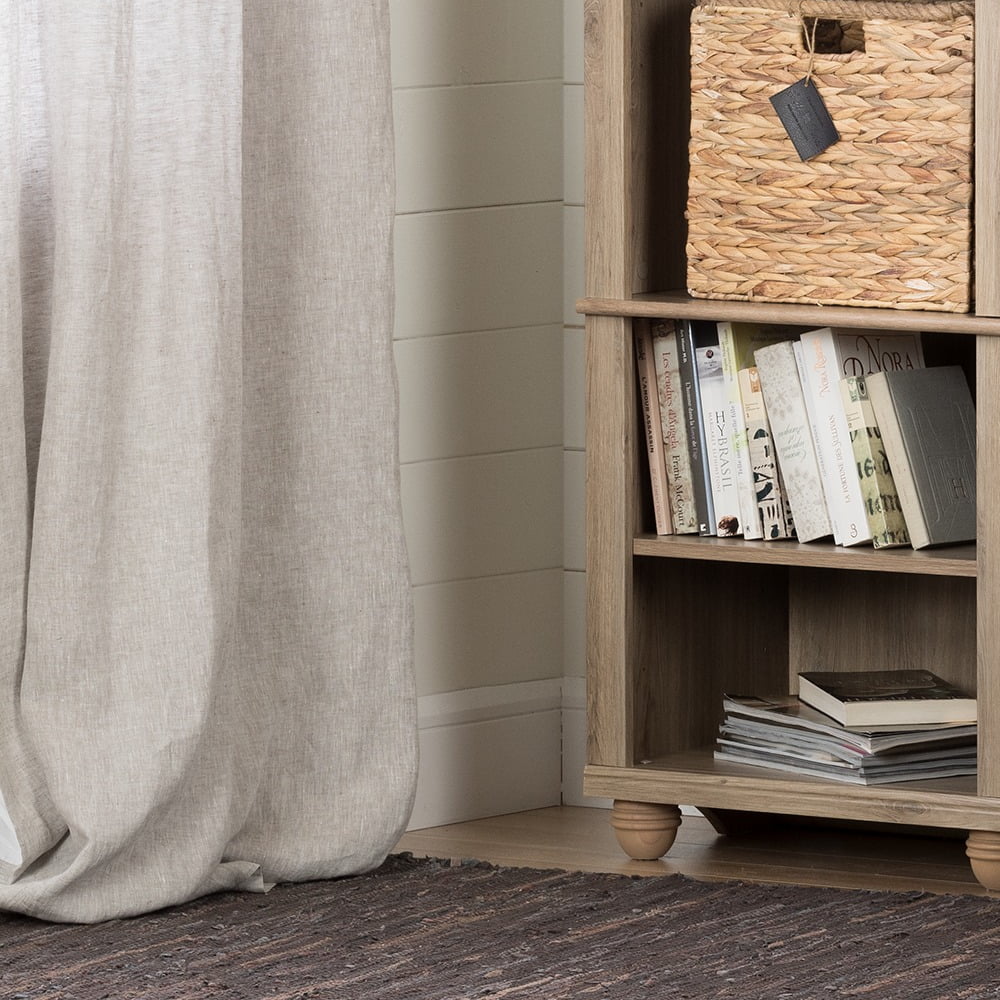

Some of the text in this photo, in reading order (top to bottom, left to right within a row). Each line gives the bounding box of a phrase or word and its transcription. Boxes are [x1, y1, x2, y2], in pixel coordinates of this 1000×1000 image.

[856, 336, 914, 374] NORA
[642, 376, 655, 453] L'AMOUR ASSASSIN
[662, 352, 680, 449] Les cendres d'Angela
[672, 455, 685, 526] Frank McCourt
[718, 437, 732, 493] BRASIL
